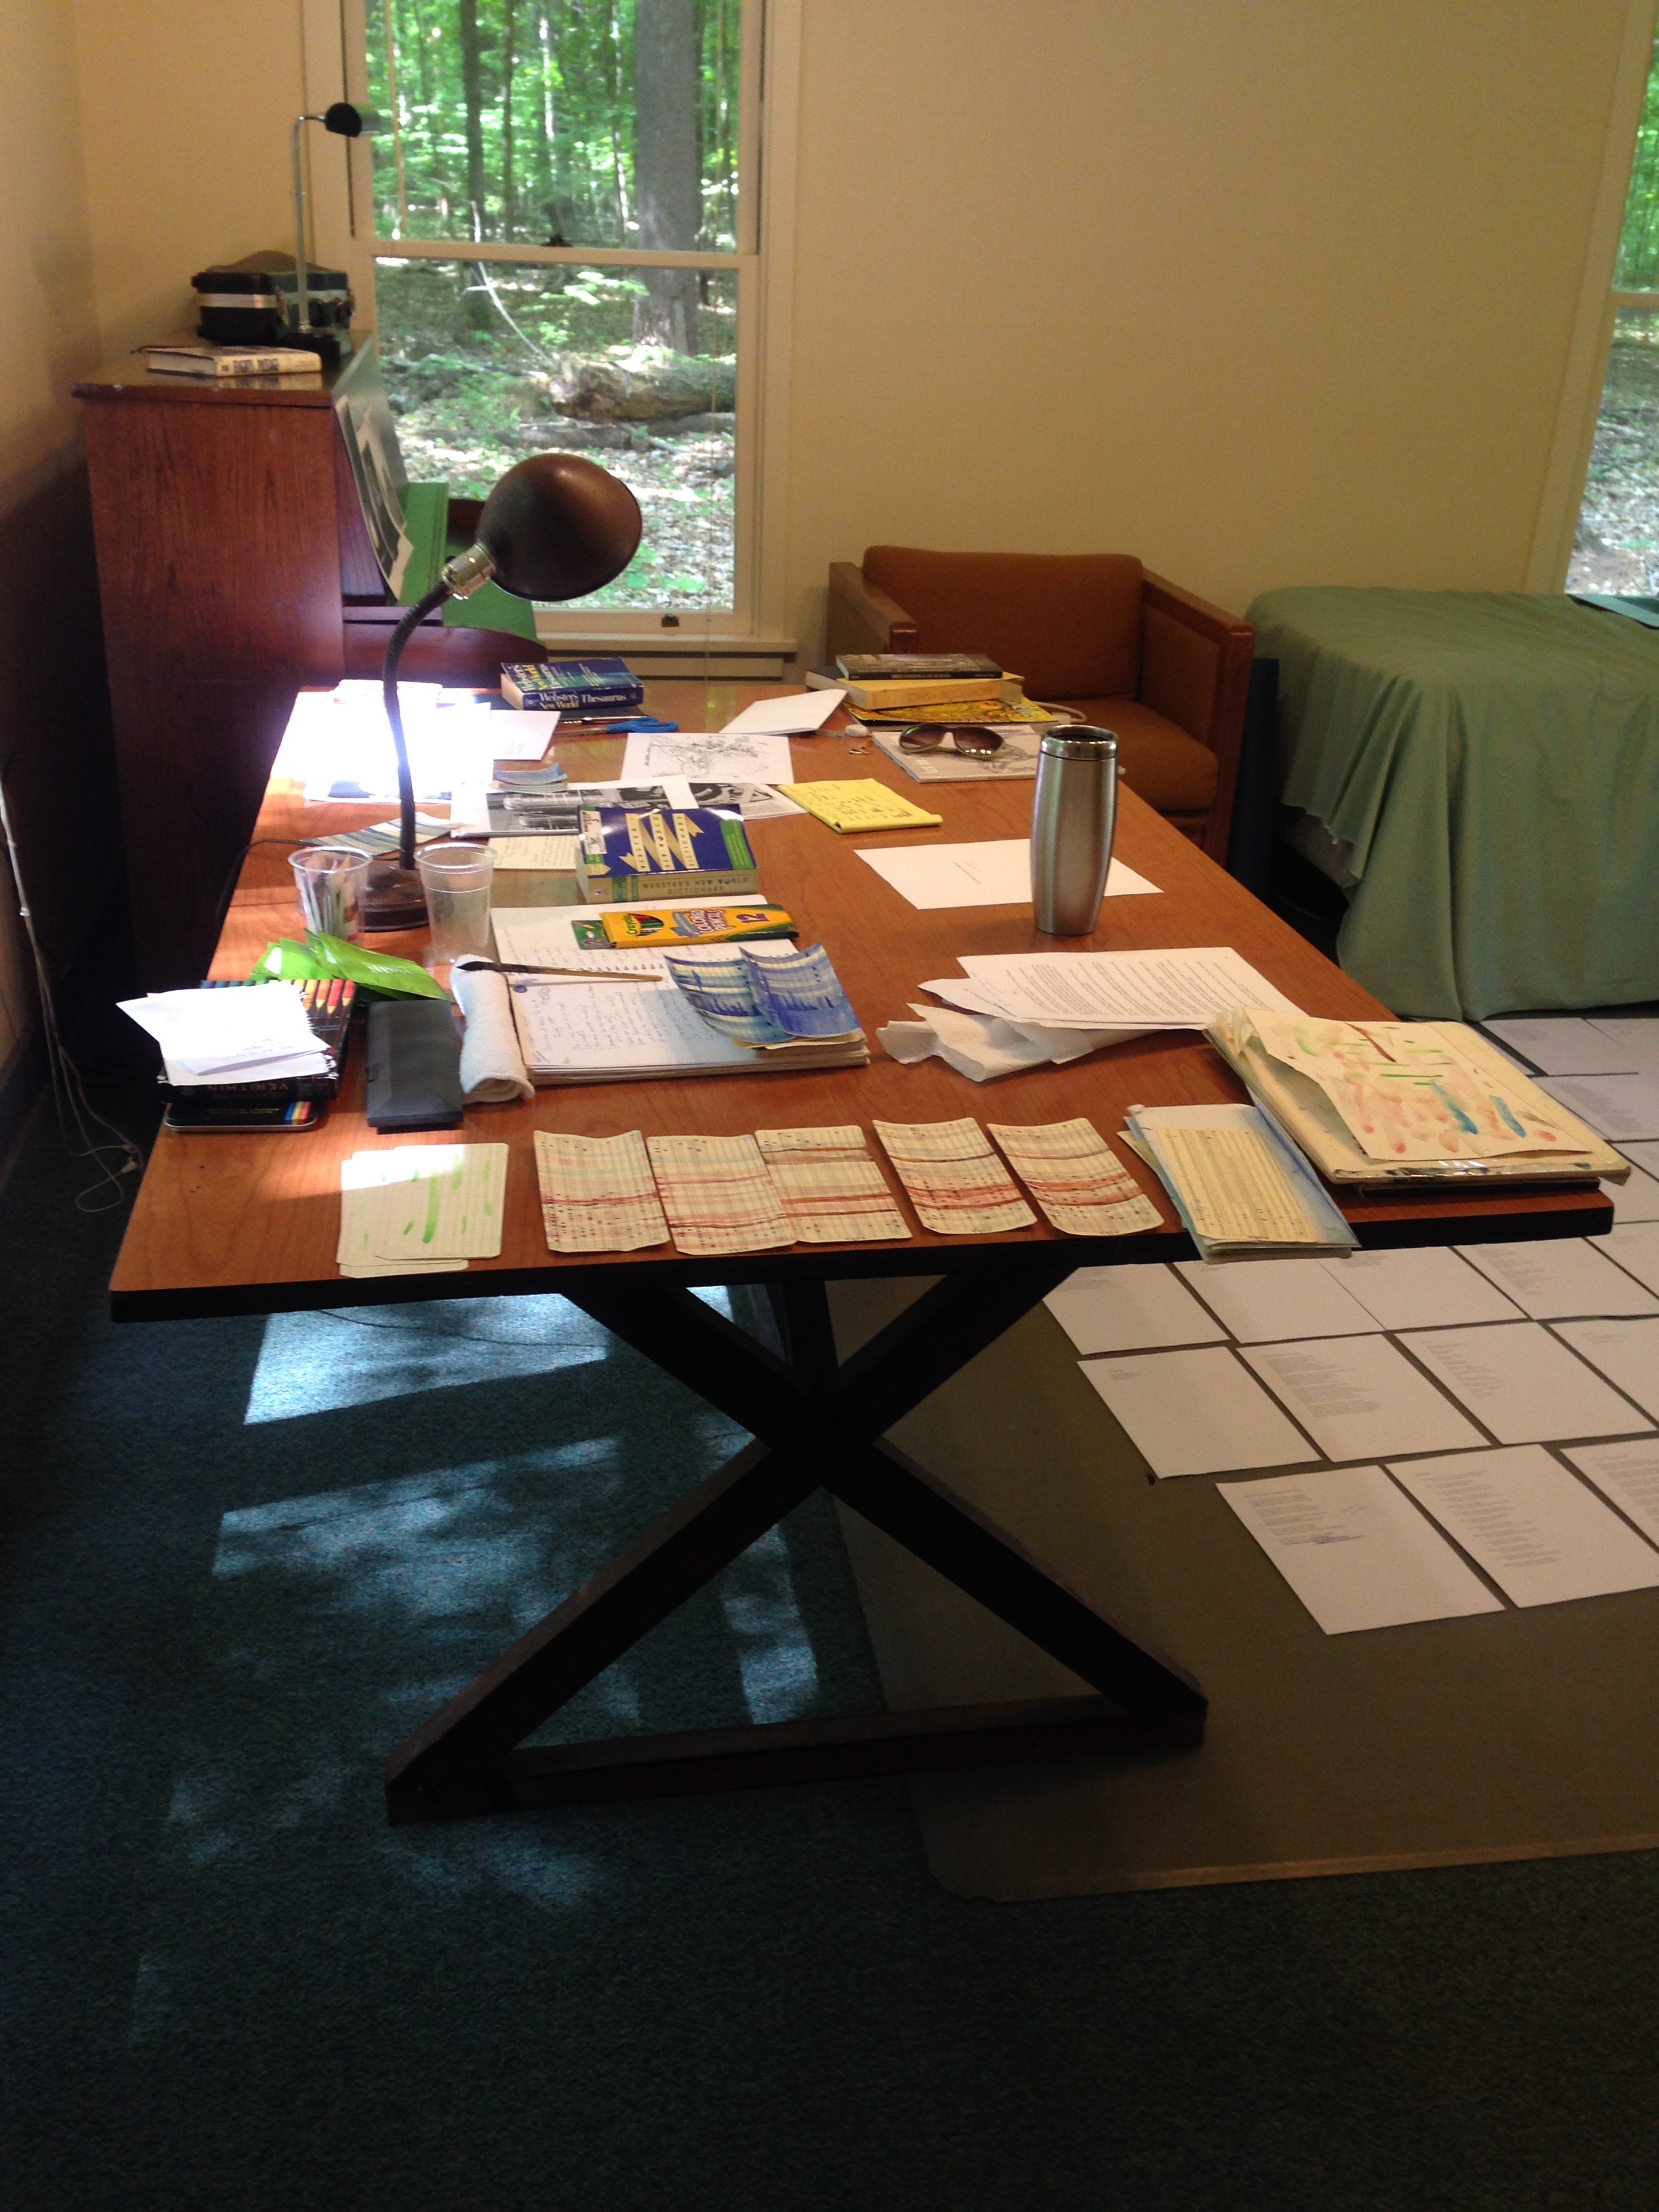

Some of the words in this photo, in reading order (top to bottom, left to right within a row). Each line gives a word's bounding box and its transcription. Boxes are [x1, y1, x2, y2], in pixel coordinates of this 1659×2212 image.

[581, 693, 627, 703] Thesaurus
[652, 817, 664, 848] WORLD
[676, 815, 695, 867] DICTIONARY
[668, 886, 724, 894] DICTIONARY
[623, 914, 638, 935] Crayola
[689, 909, 714, 934] COLORED
[707, 910, 734, 930] PENCILS
[736, 912, 770, 923] 12
